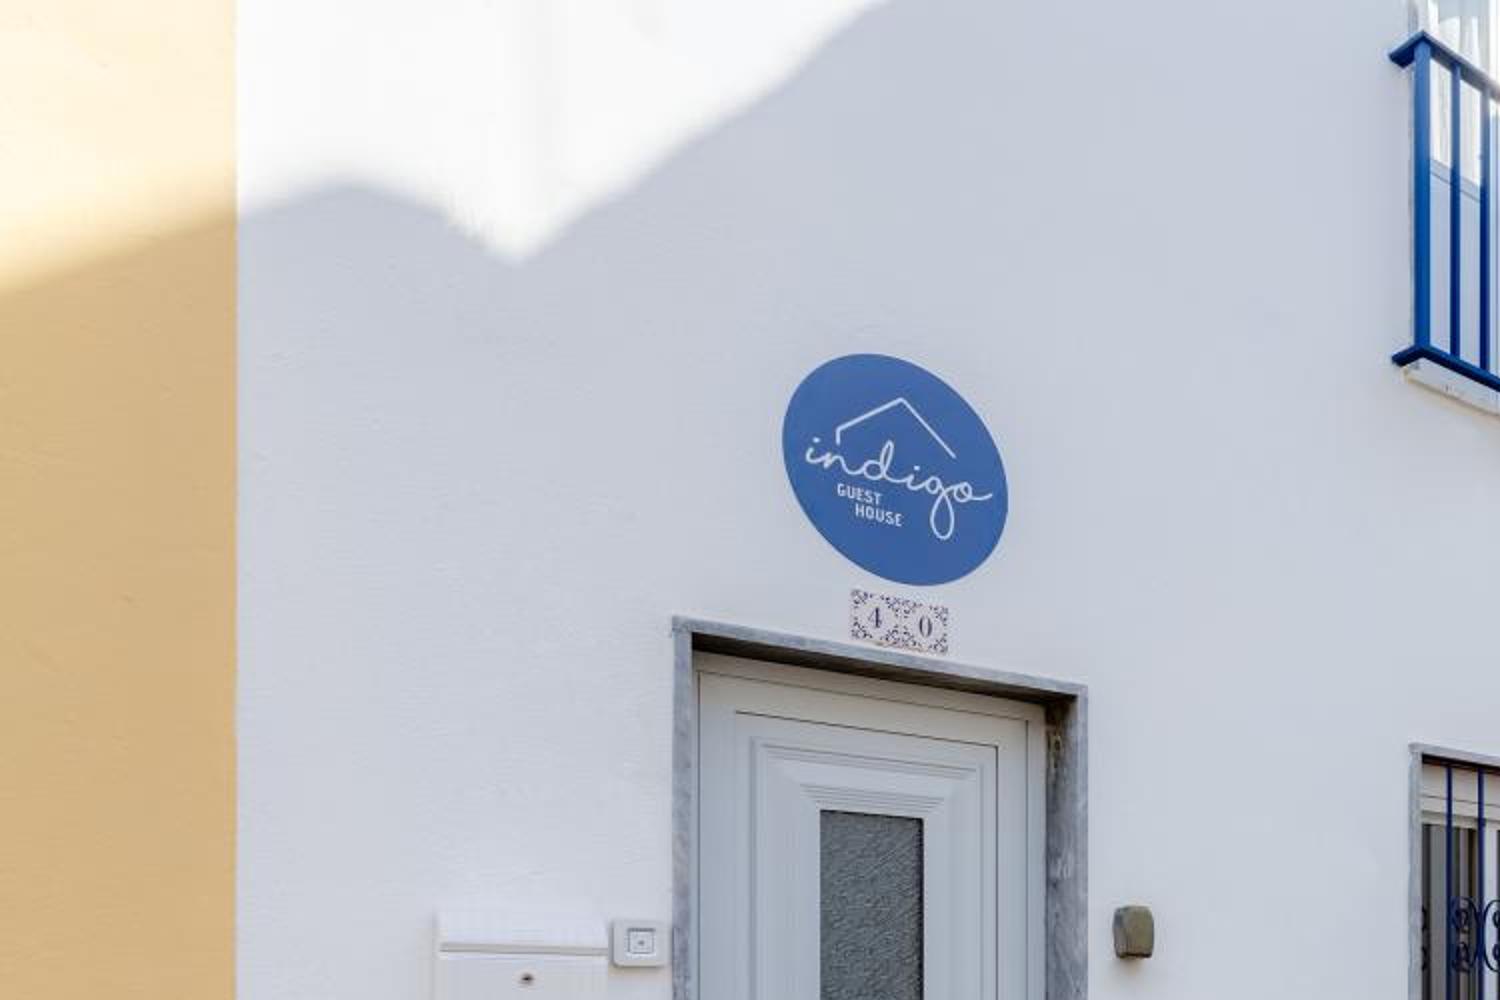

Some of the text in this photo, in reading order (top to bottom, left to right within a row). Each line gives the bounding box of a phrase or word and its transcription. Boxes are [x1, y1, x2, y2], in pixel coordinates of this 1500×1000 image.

[805, 437, 993, 541] indigo
[837, 483, 882, 505] GUEST
[855, 503, 903, 527] HOUSE
